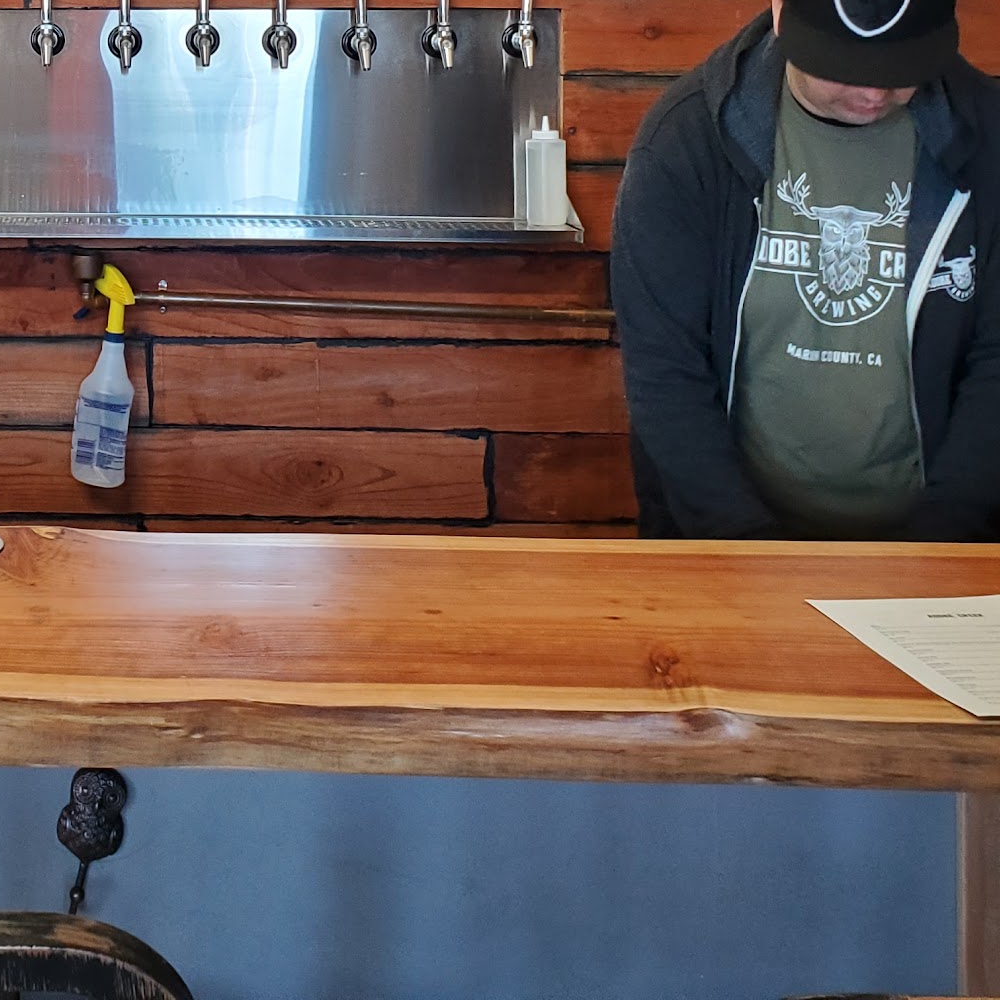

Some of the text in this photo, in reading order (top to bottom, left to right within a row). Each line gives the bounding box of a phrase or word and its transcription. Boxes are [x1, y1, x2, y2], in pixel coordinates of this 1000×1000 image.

[757, 235, 811, 268] DOBE
[804, 280, 882, 318] BREWING
[867, 352, 883, 367] CA
